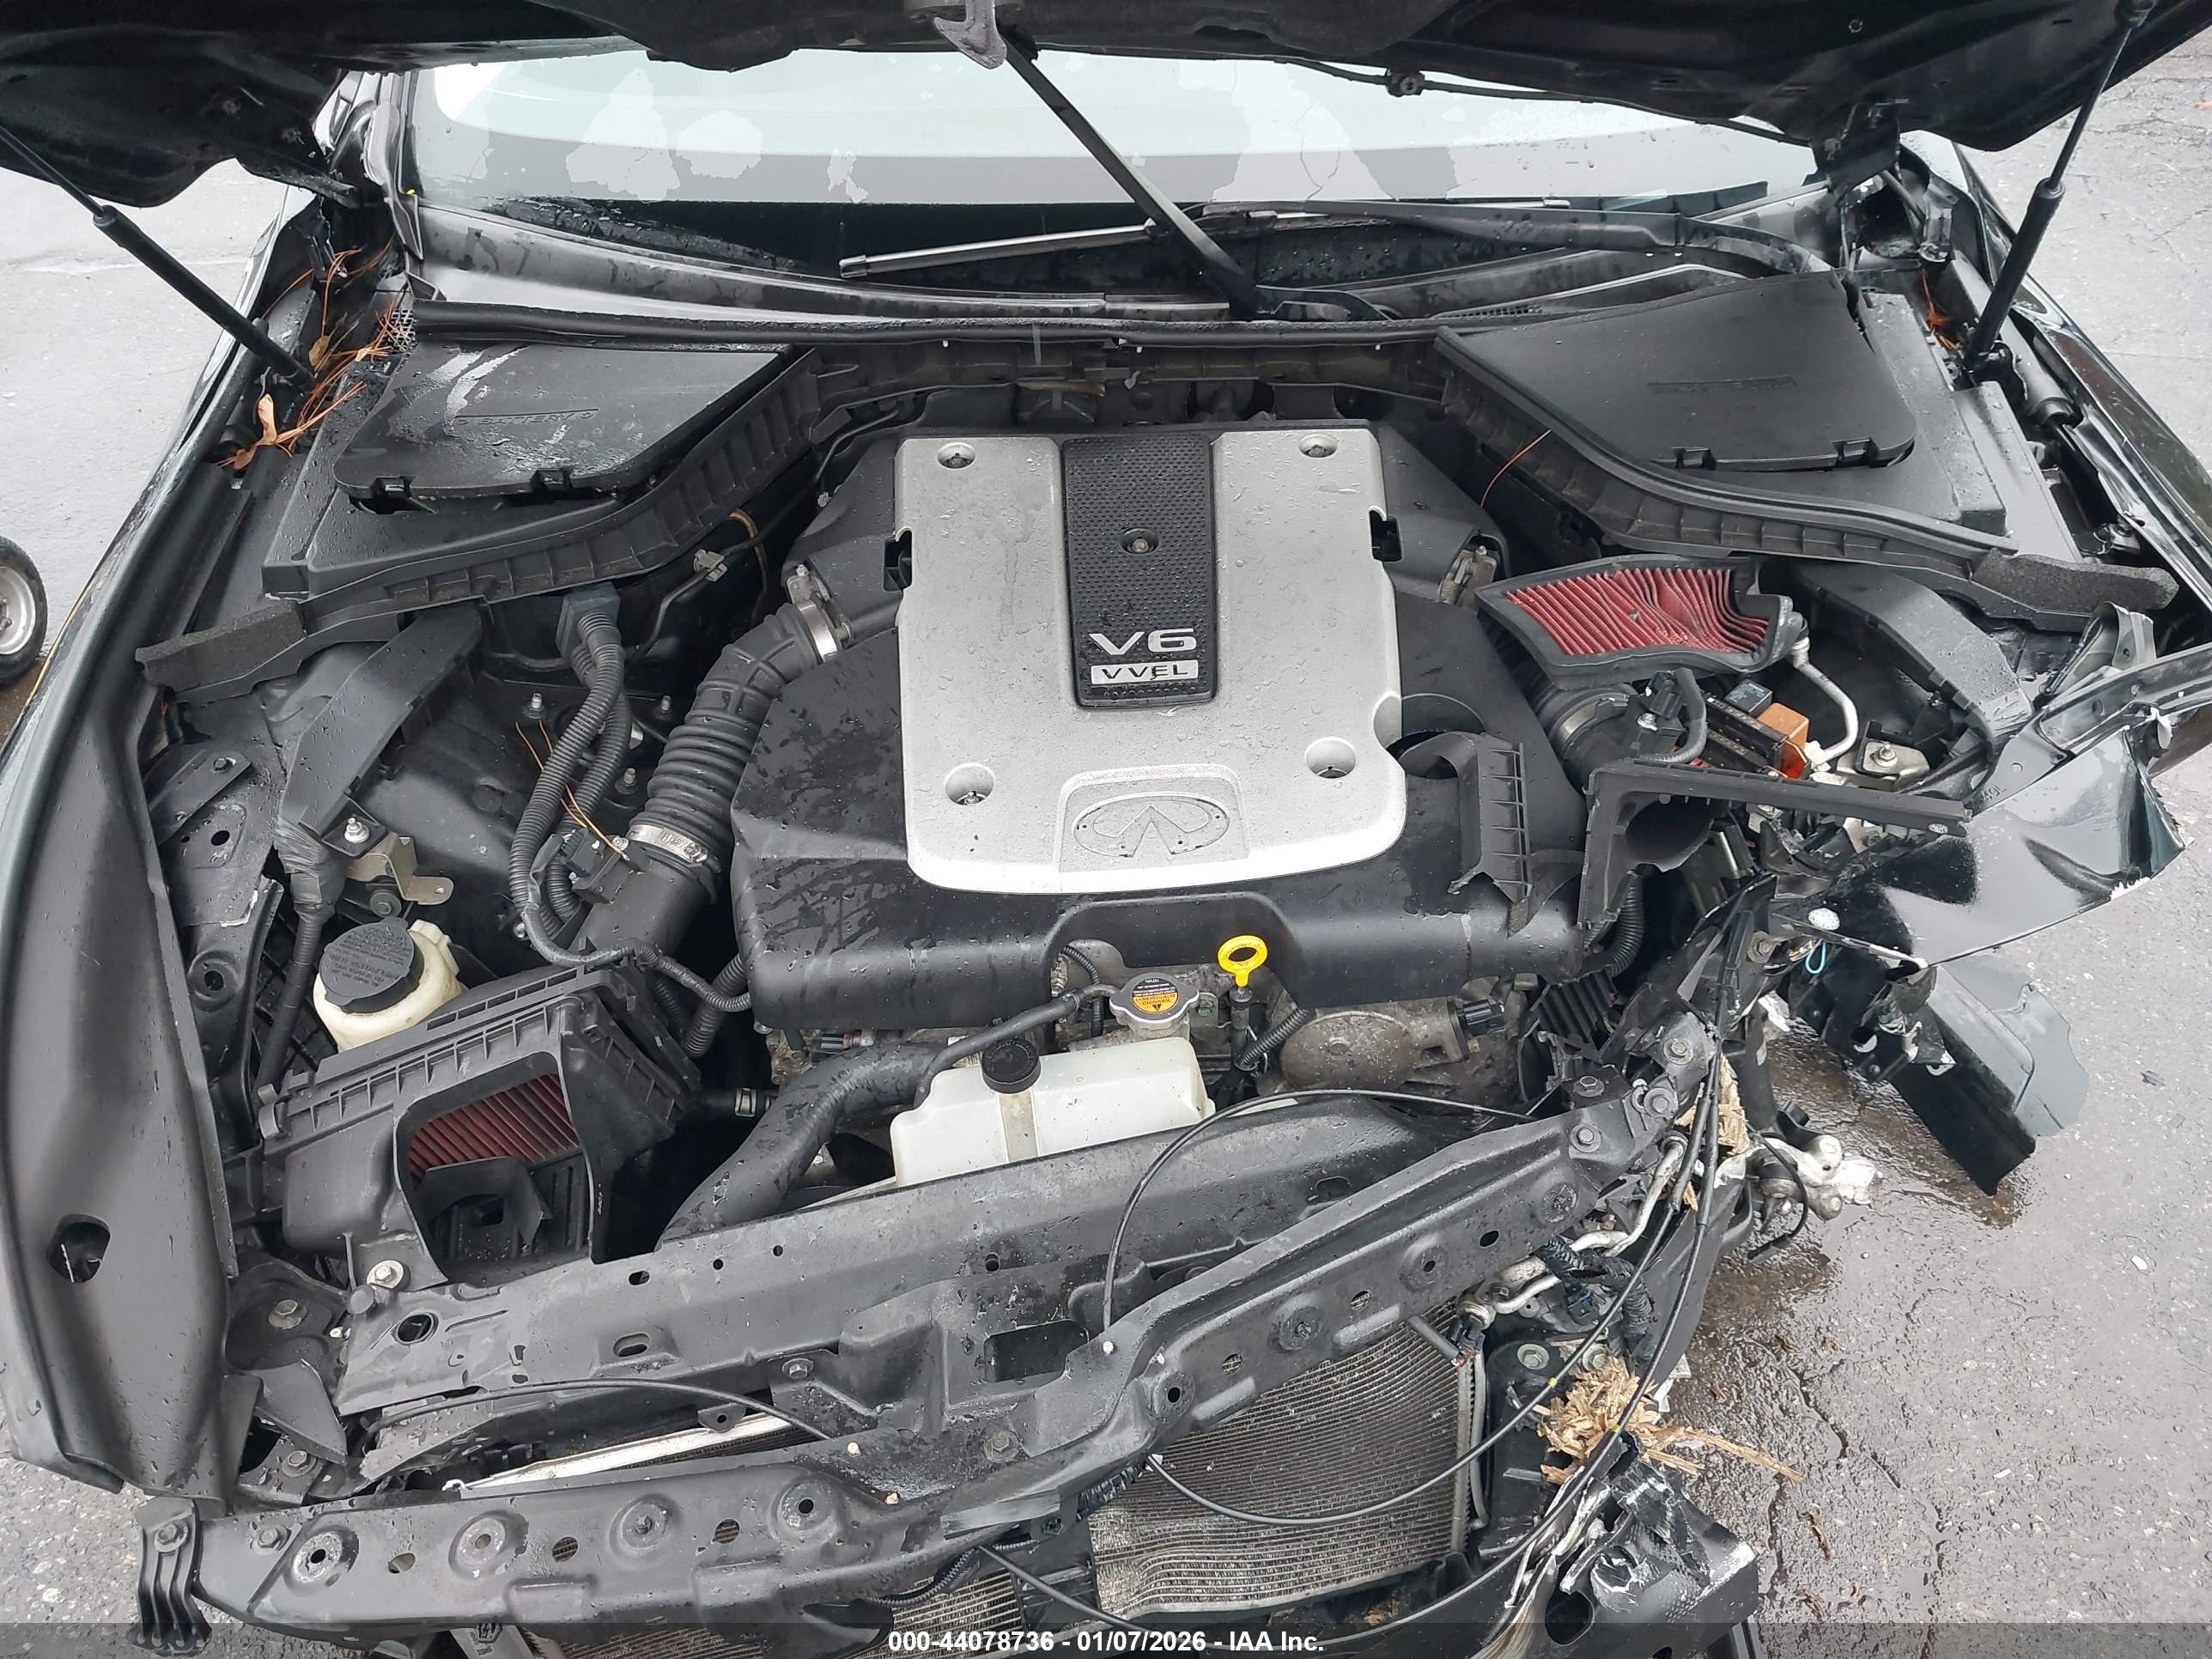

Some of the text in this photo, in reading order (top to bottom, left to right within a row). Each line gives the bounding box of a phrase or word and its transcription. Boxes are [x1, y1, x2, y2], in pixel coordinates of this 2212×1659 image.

[477, 412, 574, 425] BATTERY
[1089, 628, 1197, 655] V6
[1101, 664, 1188, 679] VVEL
